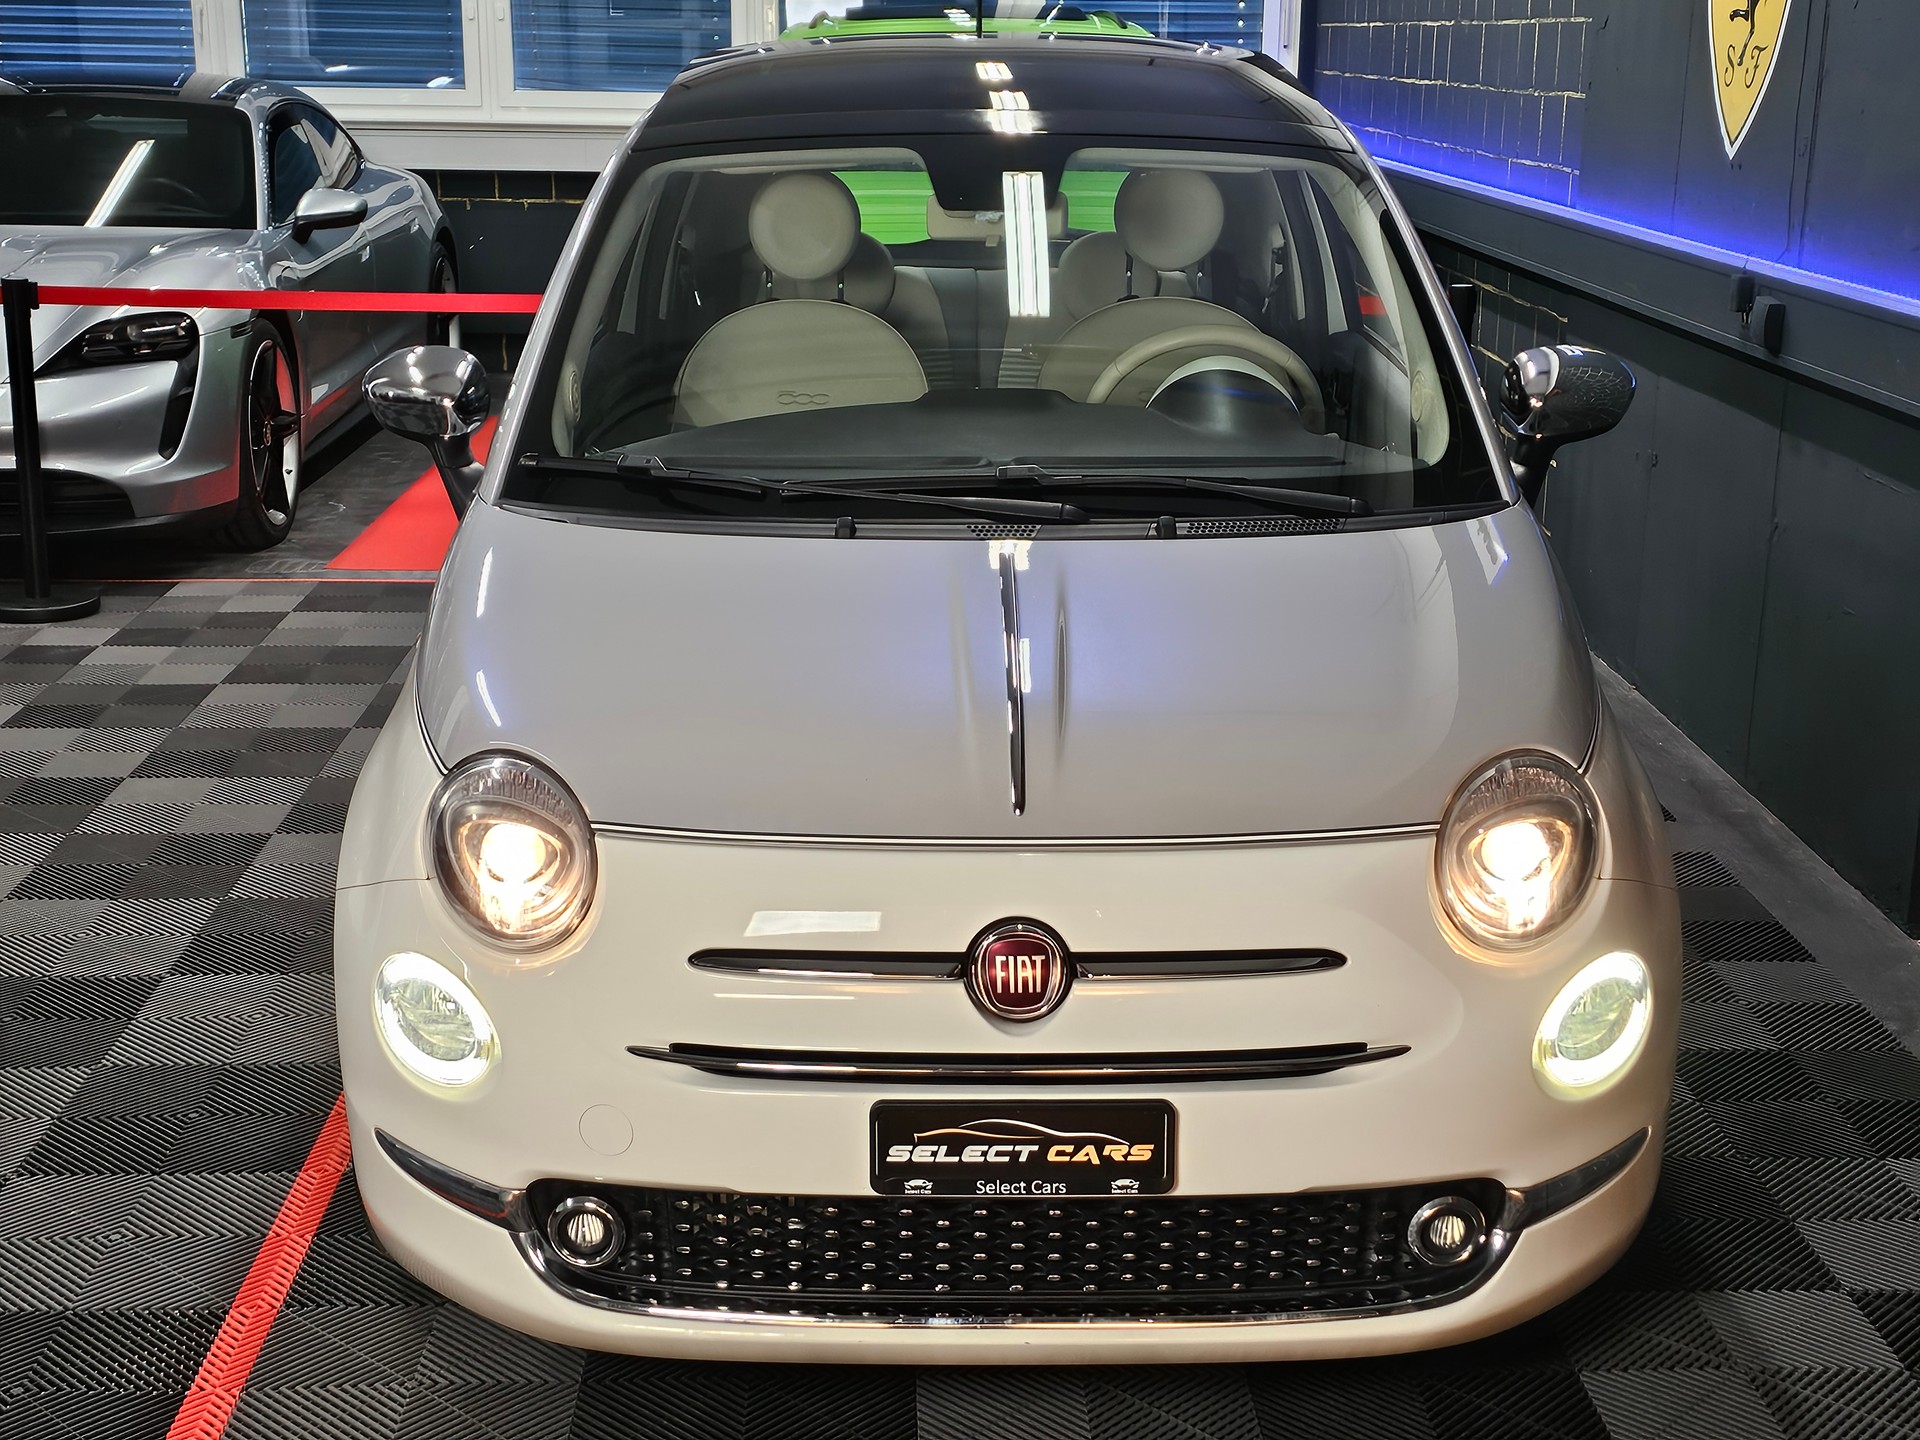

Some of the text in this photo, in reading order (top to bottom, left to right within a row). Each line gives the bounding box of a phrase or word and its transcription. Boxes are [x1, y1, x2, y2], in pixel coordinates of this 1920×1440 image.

[995, 955, 1046, 994] FIAT
[886, 1143, 1155, 1165] SELECT CARS
[976, 1179, 1067, 1195] Select Cars
